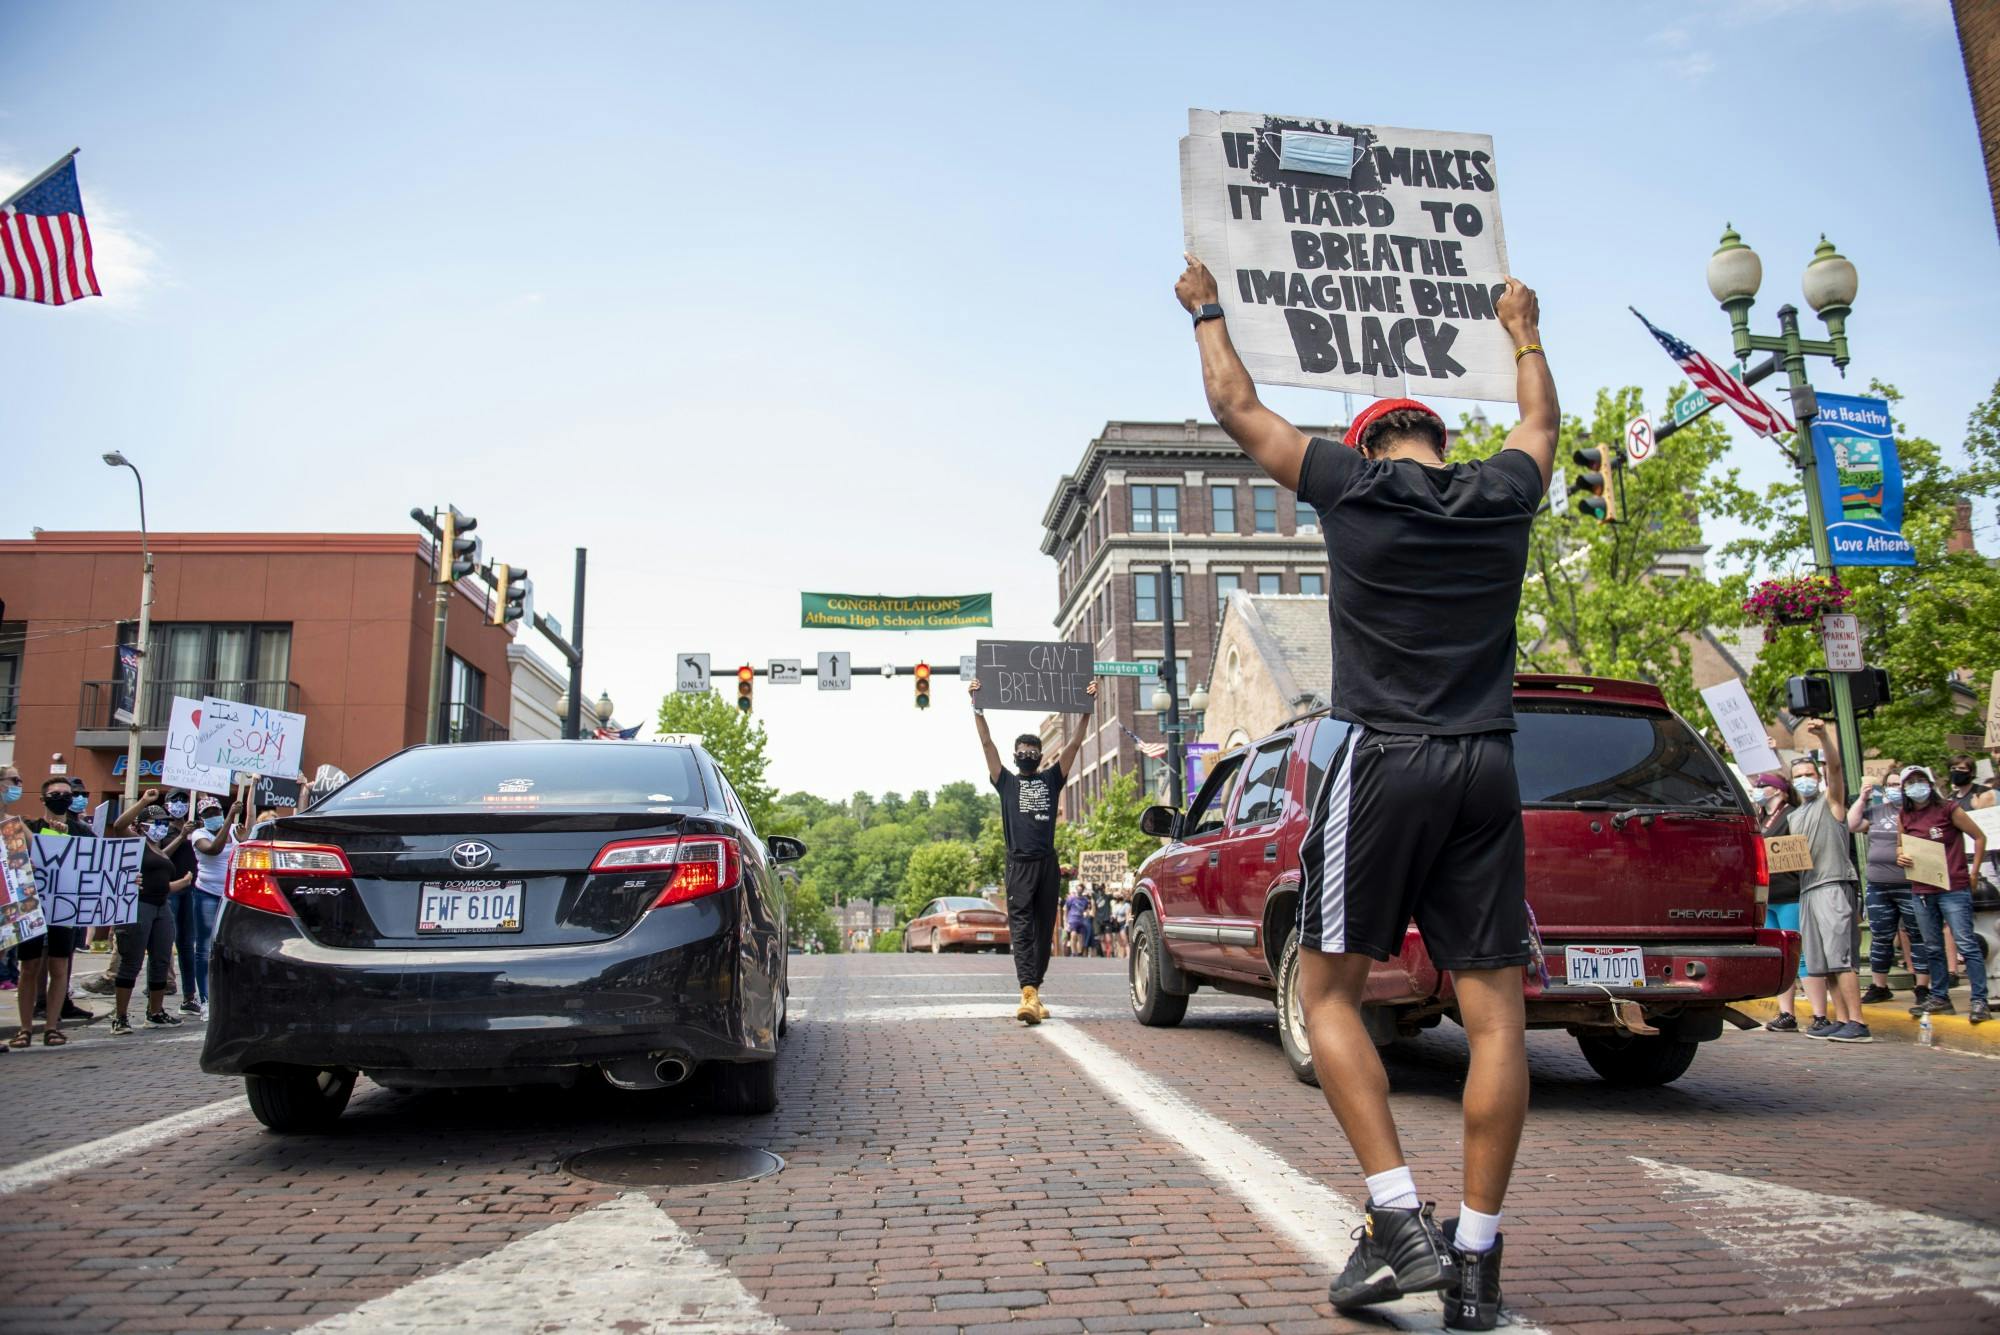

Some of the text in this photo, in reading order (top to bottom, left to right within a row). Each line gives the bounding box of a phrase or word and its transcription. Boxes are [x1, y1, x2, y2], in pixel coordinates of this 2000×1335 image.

[1221, 132, 1495, 192] IF MAKES
[1228, 184, 1483, 237] IT HARD TO
[1290, 230, 1468, 277] BREATHE
[1236, 269, 1405, 313] IMAGINE
[1284, 308, 1467, 378] BLACK
[1682, 395, 1707, 416] Cou
[1839, 407, 1887, 428] Healthy
[1833, 536, 1910, 551] Love Athens
[827, 599, 961, 612] CONGRATULATIONS
[805, 612, 989, 627] Athens High School Graduates
[1833, 620, 1845, 629] NO
[1827, 632, 1855, 640] PARKING
[981, 644, 1008, 668] I
[1028, 645, 1083, 672] CAN'T
[1094, 663, 1154, 673] shington St
[822, 680, 846, 688] ONLY
[999, 671, 1088, 706] BREATHE
[228, 729, 286, 760] SON
[217, 747, 266, 769] Next
[257, 778, 273, 791] NO
[265, 792, 297, 807] Peace
[35, 835, 140, 872] WHITE
[1083, 853, 1125, 864] ANOTHER
[1082, 864, 1117, 873] WORLD
[33, 868, 139, 896] SILENCE
[624, 880, 647, 888] SE
[51, 894, 137, 925] DEADLY
[426, 895, 515, 920] FWF 6104
[1668, 909, 1744, 919] CHEVROLET
[1573, 957, 1639, 979] HZW 7070
[1279, 941, 1298, 1031] MASTERCRAF
[1463, 1305, 1476, 1318] 23
